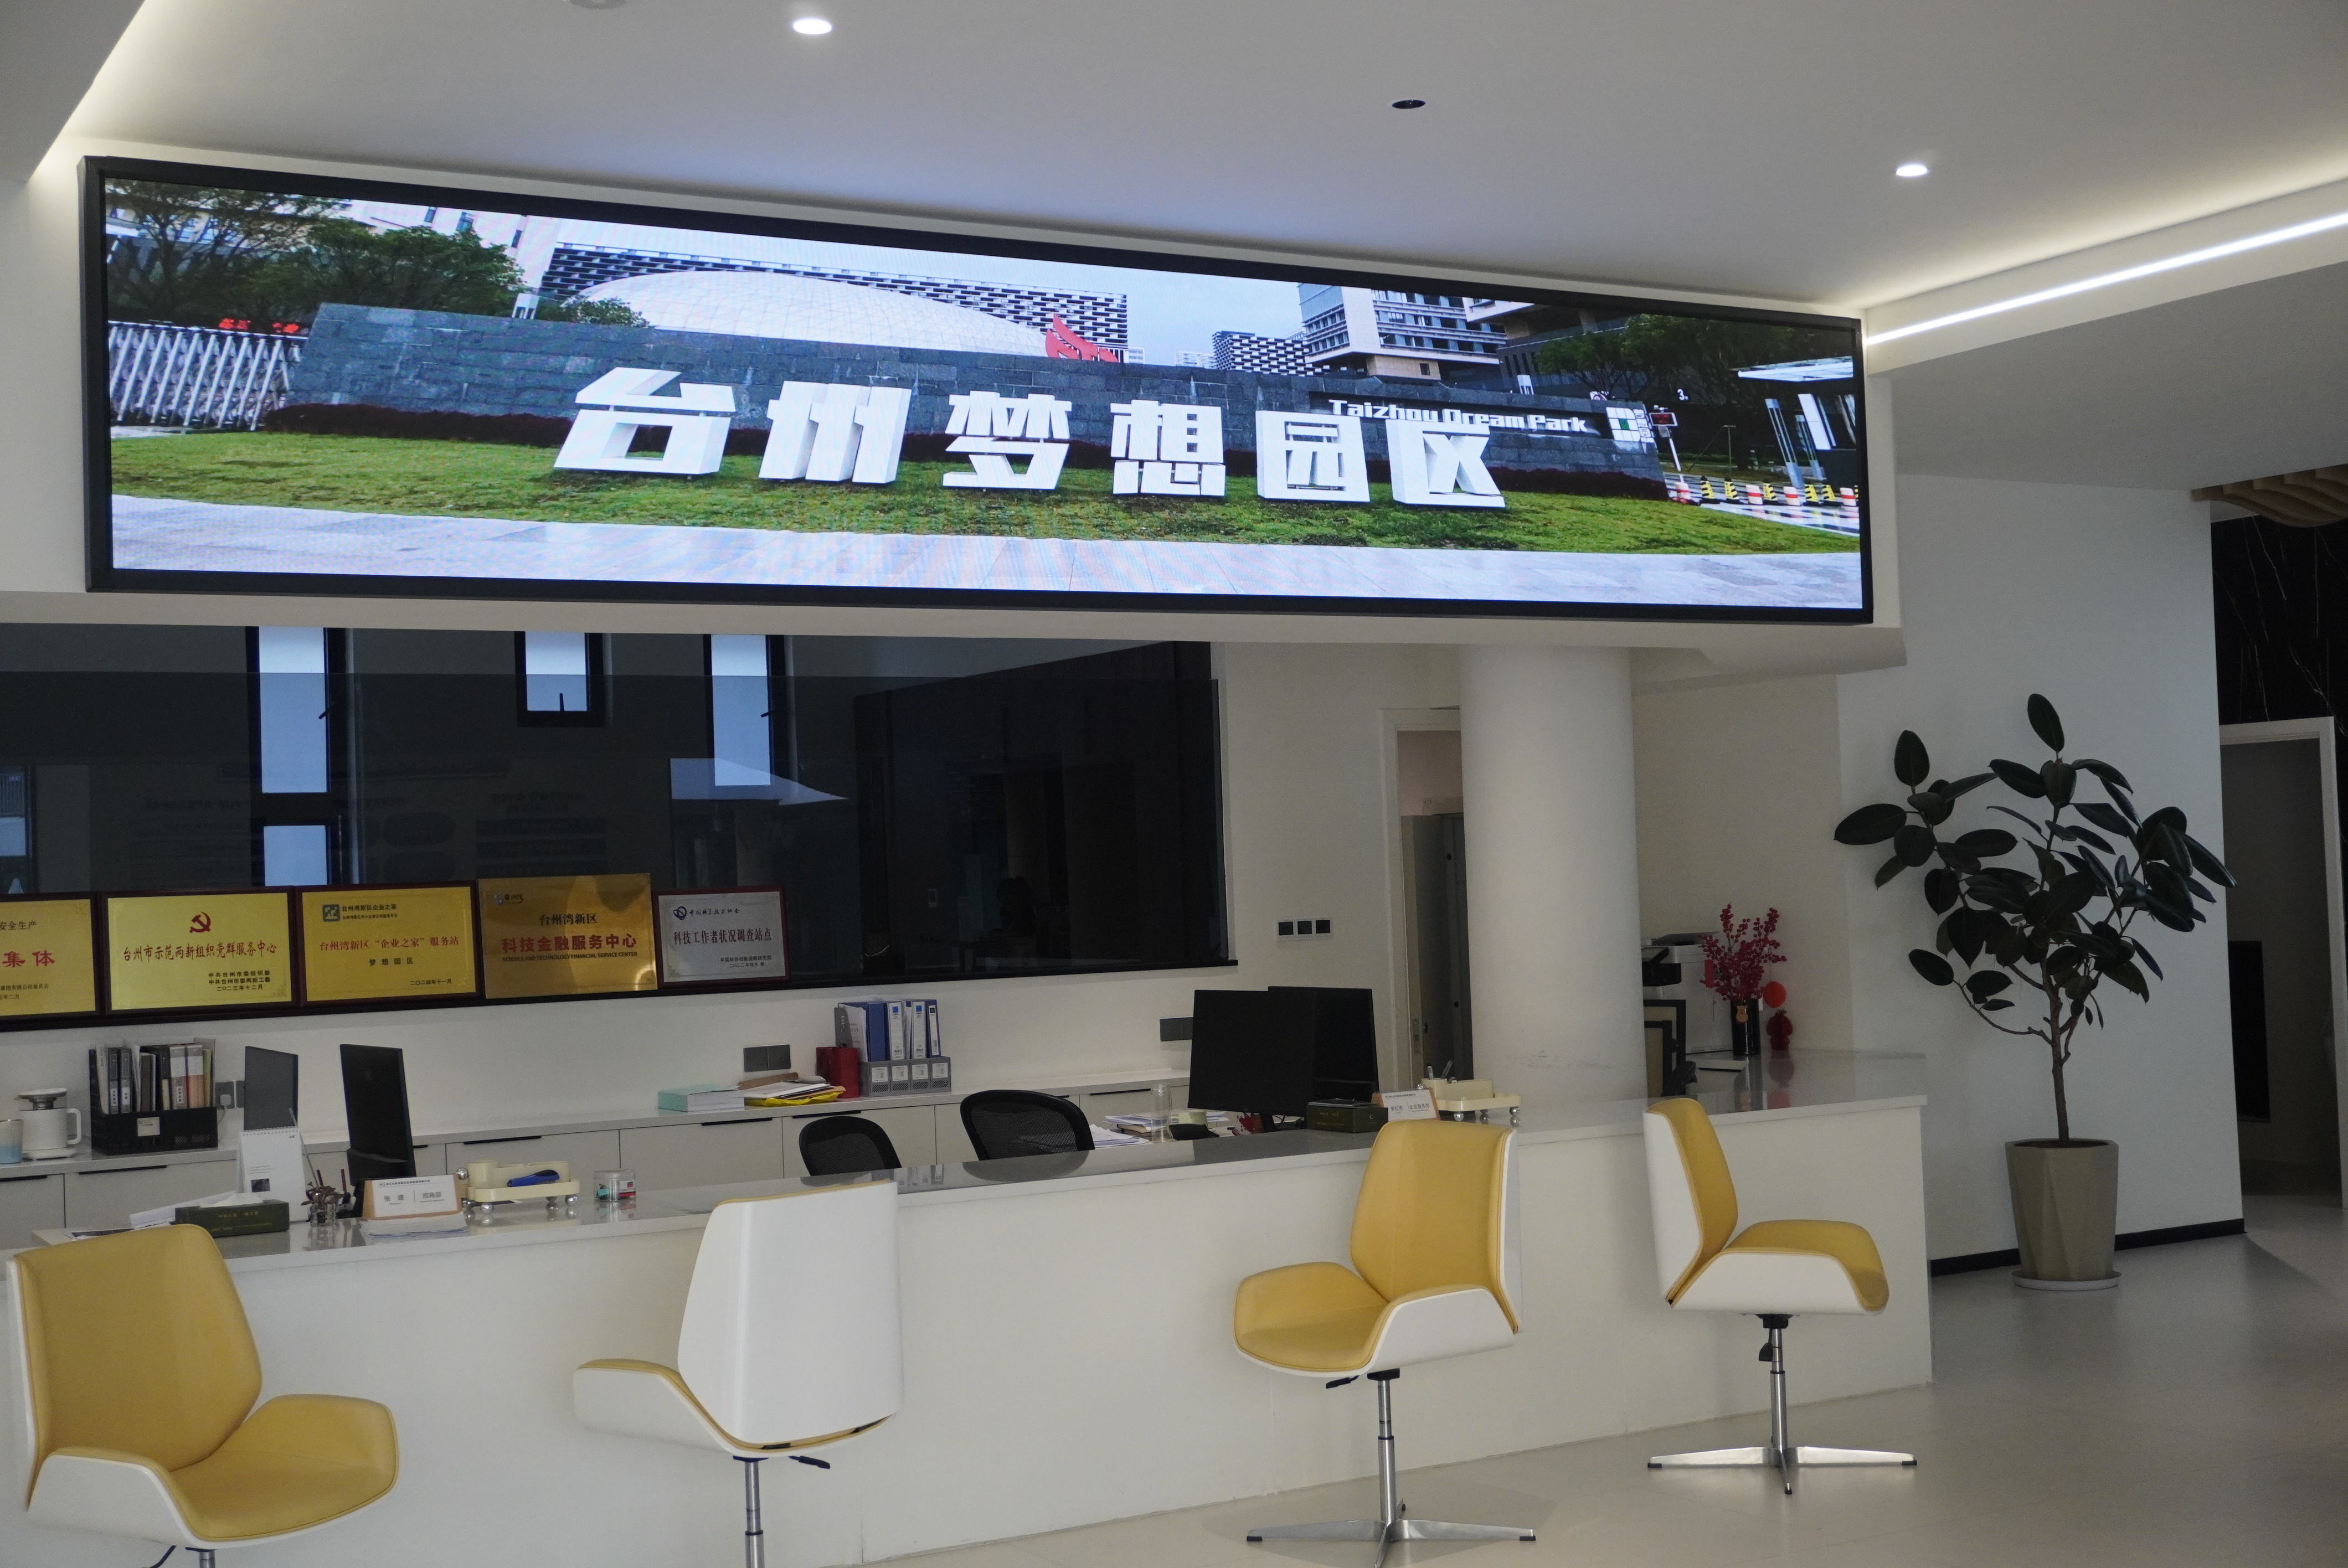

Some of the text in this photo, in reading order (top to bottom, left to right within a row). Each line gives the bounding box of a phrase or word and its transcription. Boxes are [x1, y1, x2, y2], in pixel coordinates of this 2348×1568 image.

[1329, 399, 1588, 432] Taizhou Dream Park
[554, 367, 1505, 508] 台州梦想园区
[539, 913, 598, 926] 台州湾新区
[502, 933, 637, 953] 科技金融服务中心
[673, 927, 772, 945] 科技工作者状况调查站点
[2, 950, 55, 968] 集体
[123, 940, 277, 962] 台州市示范两新组织党群服务中心
[369, 957, 414, 966] 梦想园区
